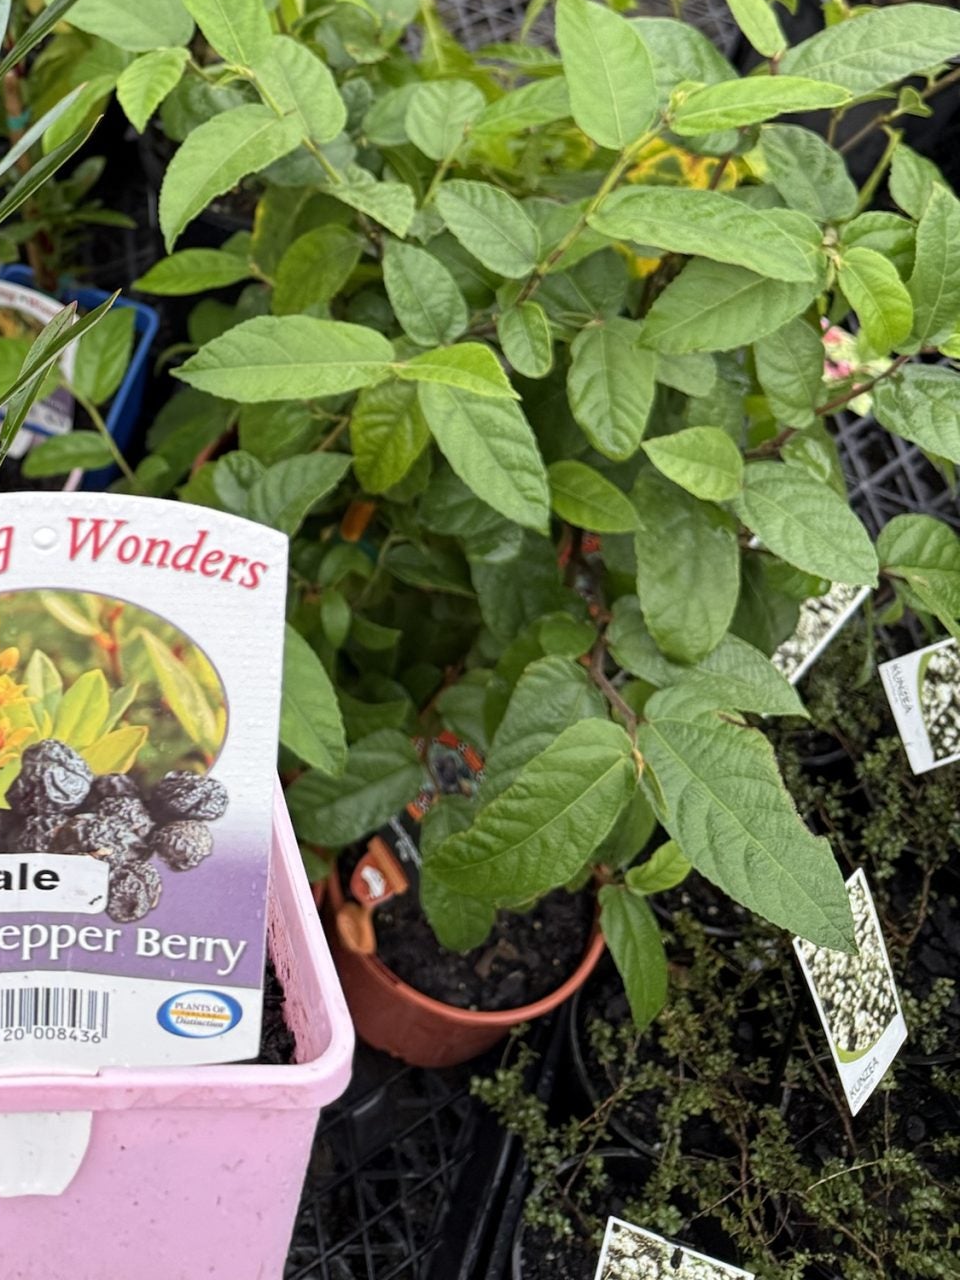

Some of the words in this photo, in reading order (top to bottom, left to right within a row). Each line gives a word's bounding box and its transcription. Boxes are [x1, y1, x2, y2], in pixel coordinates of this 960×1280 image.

[67, 516, 269, 590] Wonders
[135, 927, 248, 976] Berry
[174, 1001, 211, 1013] PLANTS
[33, 1026, 102, 1045] 008436
